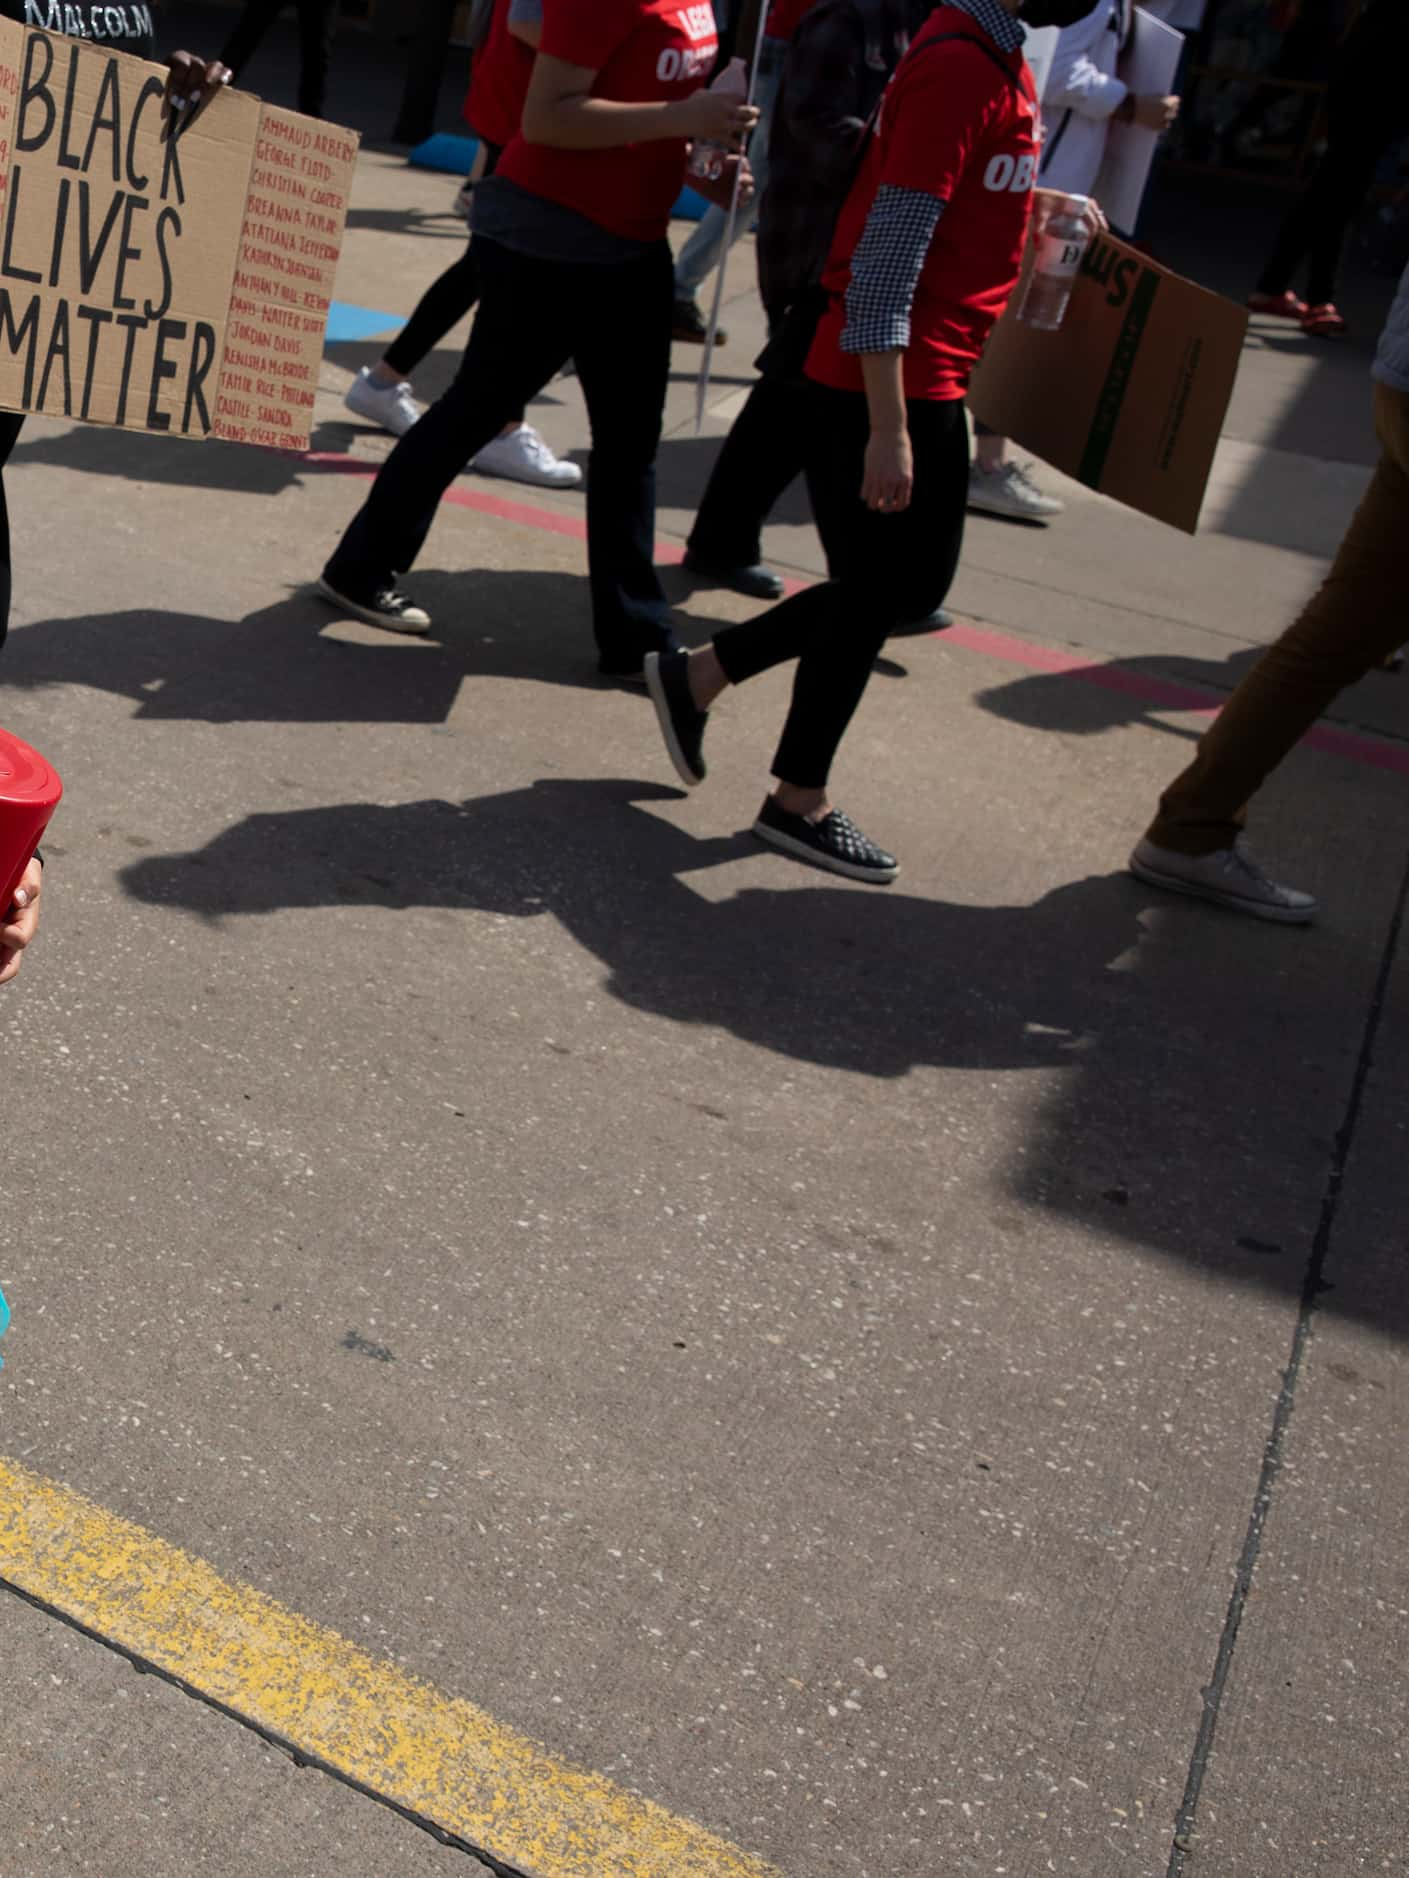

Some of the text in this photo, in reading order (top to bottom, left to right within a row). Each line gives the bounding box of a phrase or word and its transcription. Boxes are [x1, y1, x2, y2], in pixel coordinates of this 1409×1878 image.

[25, 0, 153, 38] MALCOLM
[0, 140, 8, 162] 9
[16, 32, 185, 204] BLACK
[2, 165, 182, 320] LIVES
